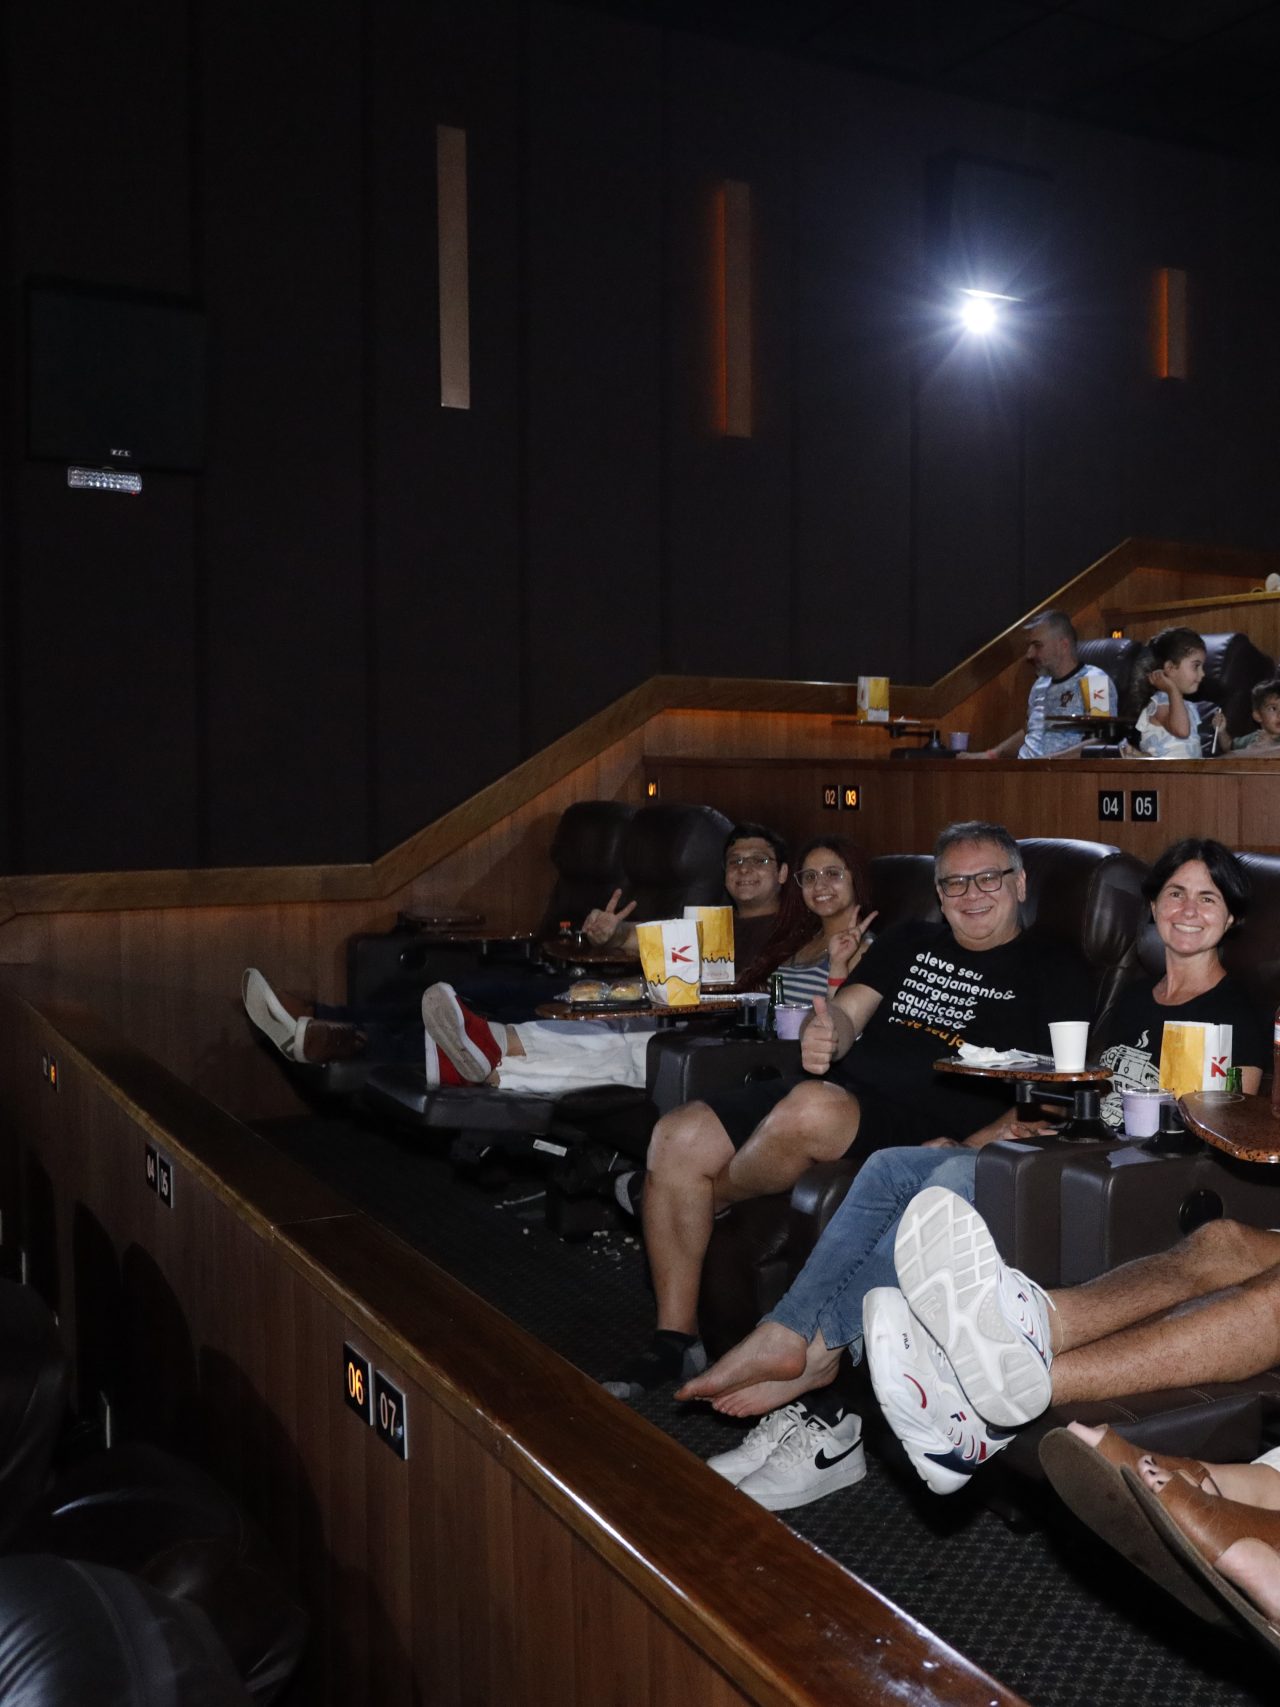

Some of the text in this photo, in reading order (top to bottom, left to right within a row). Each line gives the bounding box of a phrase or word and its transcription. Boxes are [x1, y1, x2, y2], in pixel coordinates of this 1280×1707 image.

[825, 789, 836, 805] 02
[845, 789, 857, 806] 03
[1102, 796, 1119, 815] 04
[1135, 796, 1152, 816] 05
[915, 951, 984, 981] eleve seu
[347, 1361, 364, 1407] 06
[379, 1391, 397, 1437] 07
